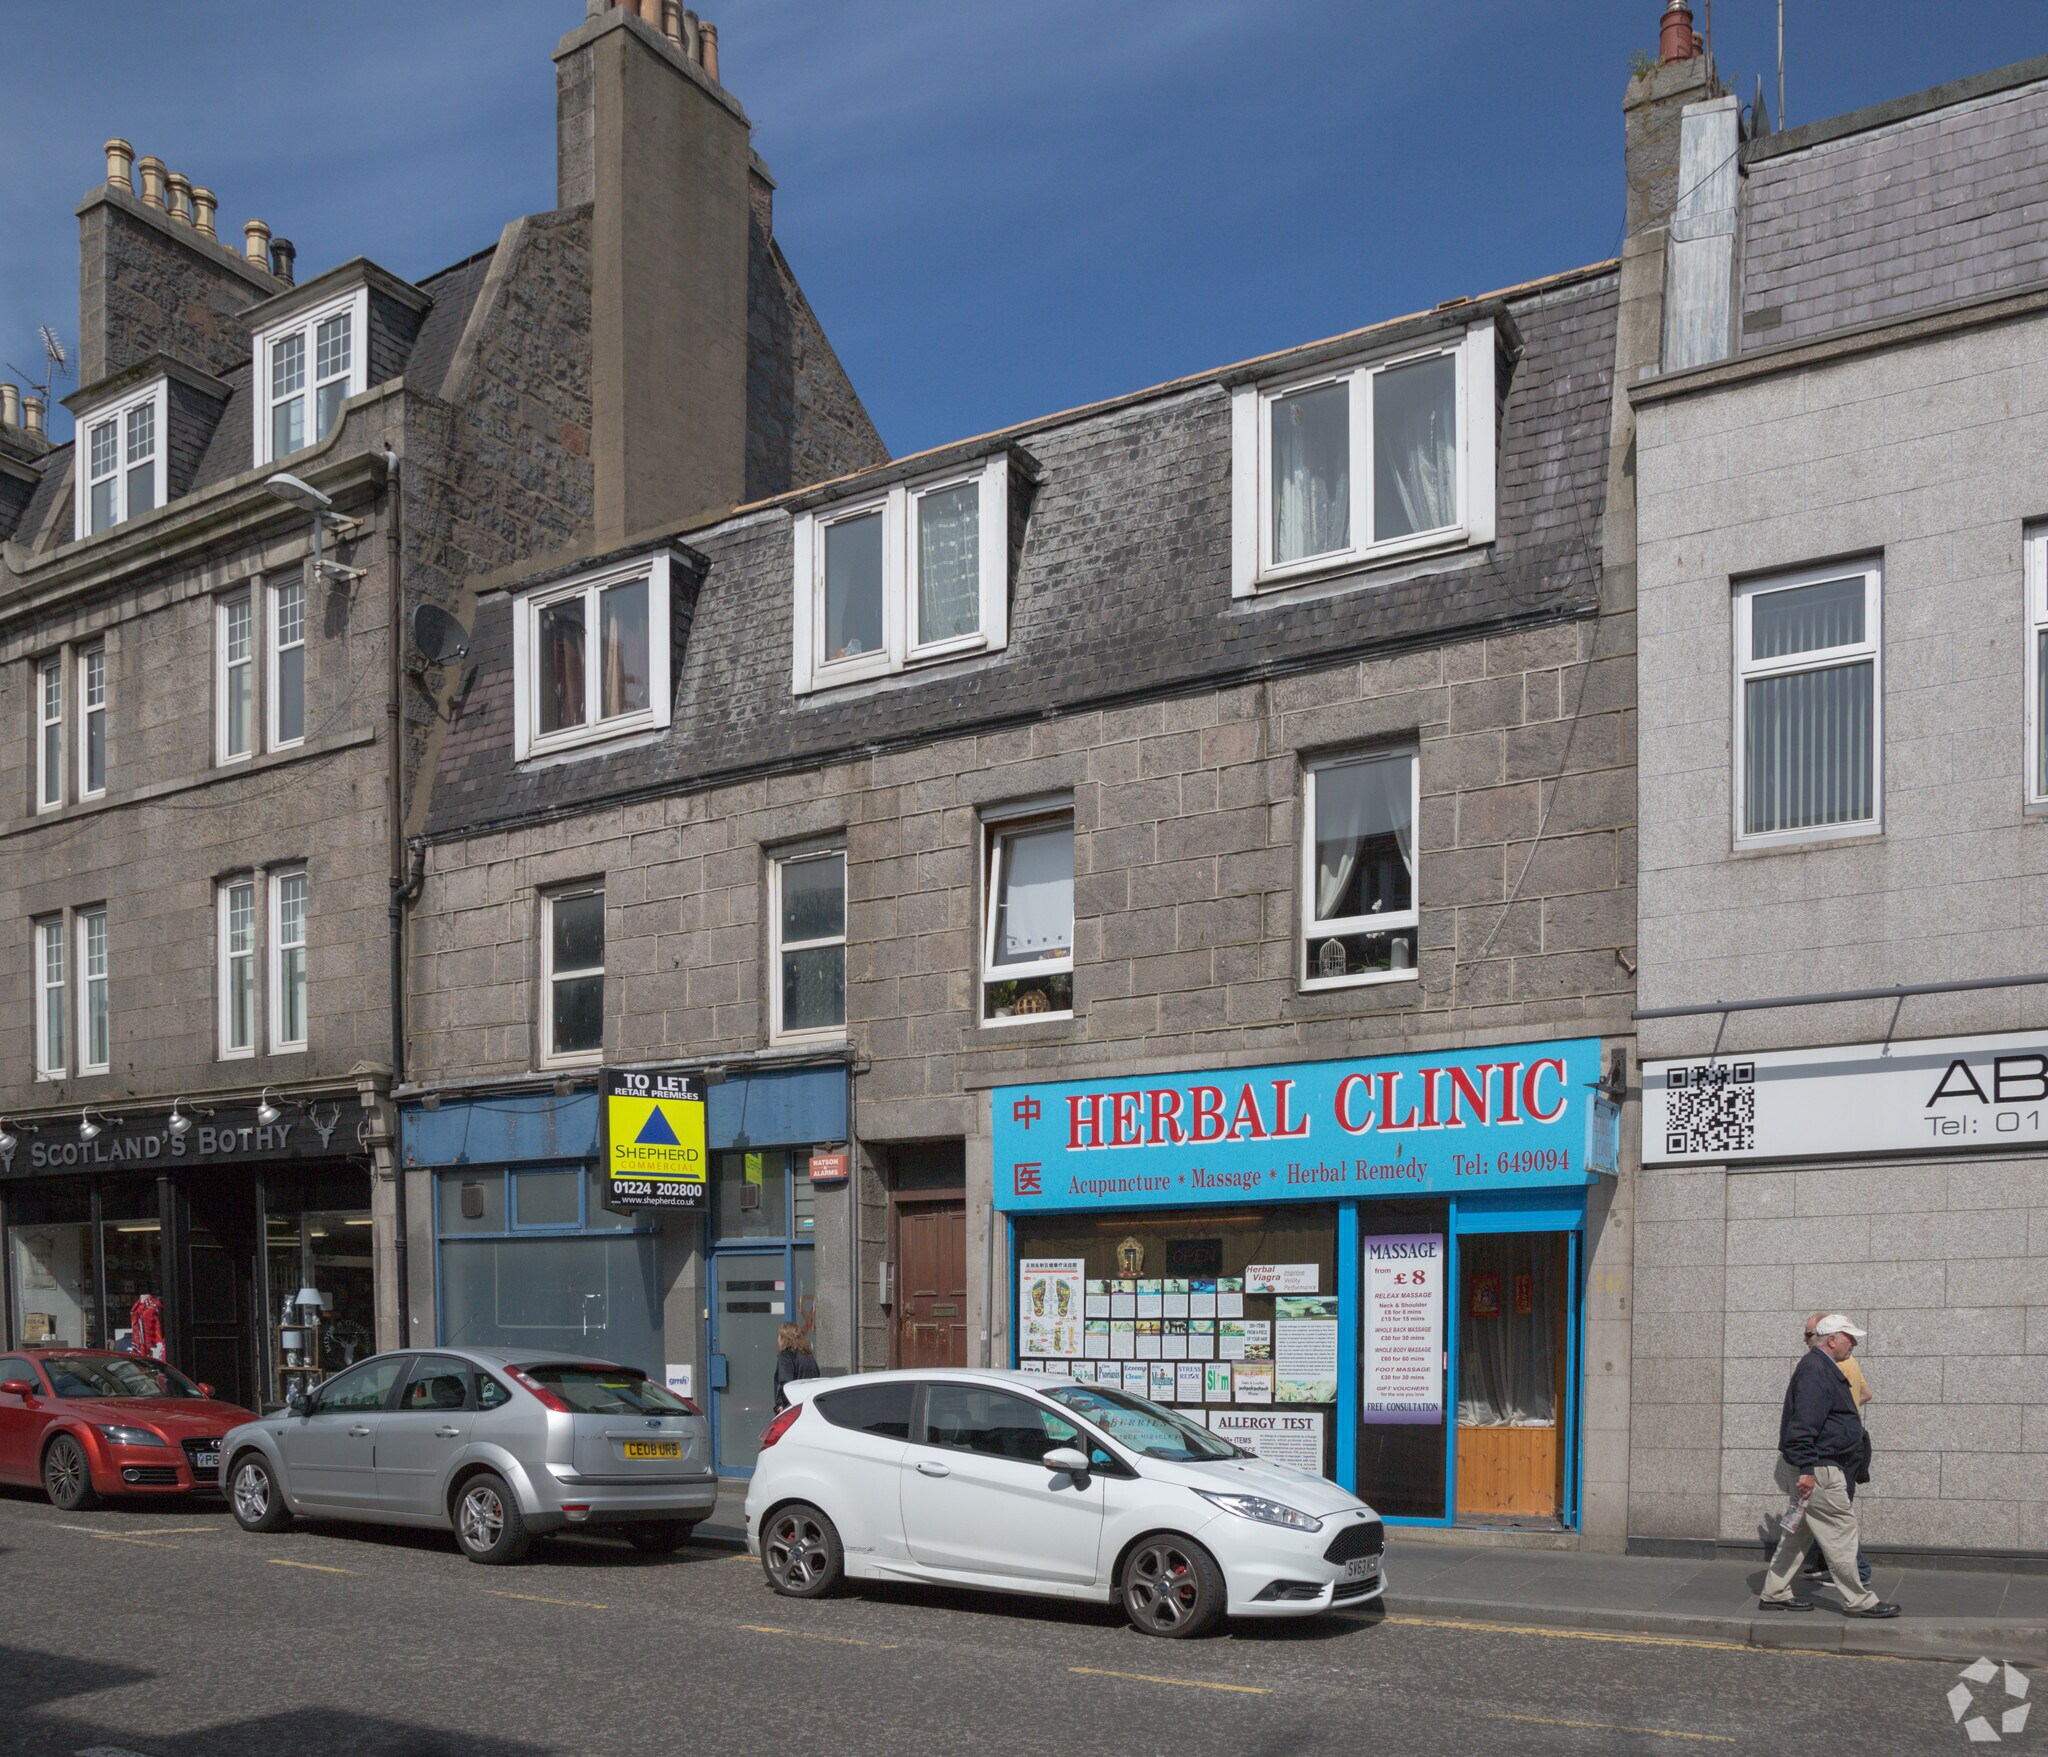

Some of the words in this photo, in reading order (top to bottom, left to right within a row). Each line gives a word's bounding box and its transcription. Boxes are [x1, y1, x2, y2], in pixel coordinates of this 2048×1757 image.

[624, 1073, 650, 1090] TO
[657, 1075, 690, 1092] LET
[615, 1087, 648, 1097] RETAIL
[651, 1090, 699, 1101] PREMISES
[1065, 1079, 1311, 1152] HERBAL
[1334, 1057, 1568, 1136] CLINIC
[1924, 1115, 1977, 1136] Tel:
[31, 1129, 187, 1168] SCOTLAND'S
[198, 1124, 292, 1155] BOTHY
[1013, 1095, 1043, 1196] 中医
[615, 1145, 699, 1162] SHEPHERD
[621, 1160, 695, 1172] COMMERCIAL
[813, 1158, 839, 1167] WATSON
[813, 1169, 839, 1177] ALARMS
[1068, 1174, 1171, 1198] Acupuncture
[1191, 1168, 1261, 1191] Massage
[1287, 1160, 1347, 1184] Herbal
[1356, 1156, 1428, 1182] Remedy
[1452, 1153, 1489, 1176] Tel:
[1497, 1149, 1570, 1174] 649094
[614, 1181, 652, 1195] 01224
[657, 1183, 702, 1197] 202800
[622, 1196, 695, 1206] www.shepherd.co.uk
[1369, 1242, 1437, 1260] MASSAGE
[1246, 1265, 1275, 1273] Herbal
[1253, 1273, 1281, 1282] Viagra
[1367, 1402, 1384, 1412] FREE
[1386, 1402, 1439, 1412] CONSULTATION
[1218, 1417, 1276, 1429] ALLERGY
[1282, 1418, 1314, 1430] TEST
[1234, 1436, 1252, 1444] ITEMS
[629, 1443, 657, 1456] CE08
[660, 1443, 678, 1456] URB
